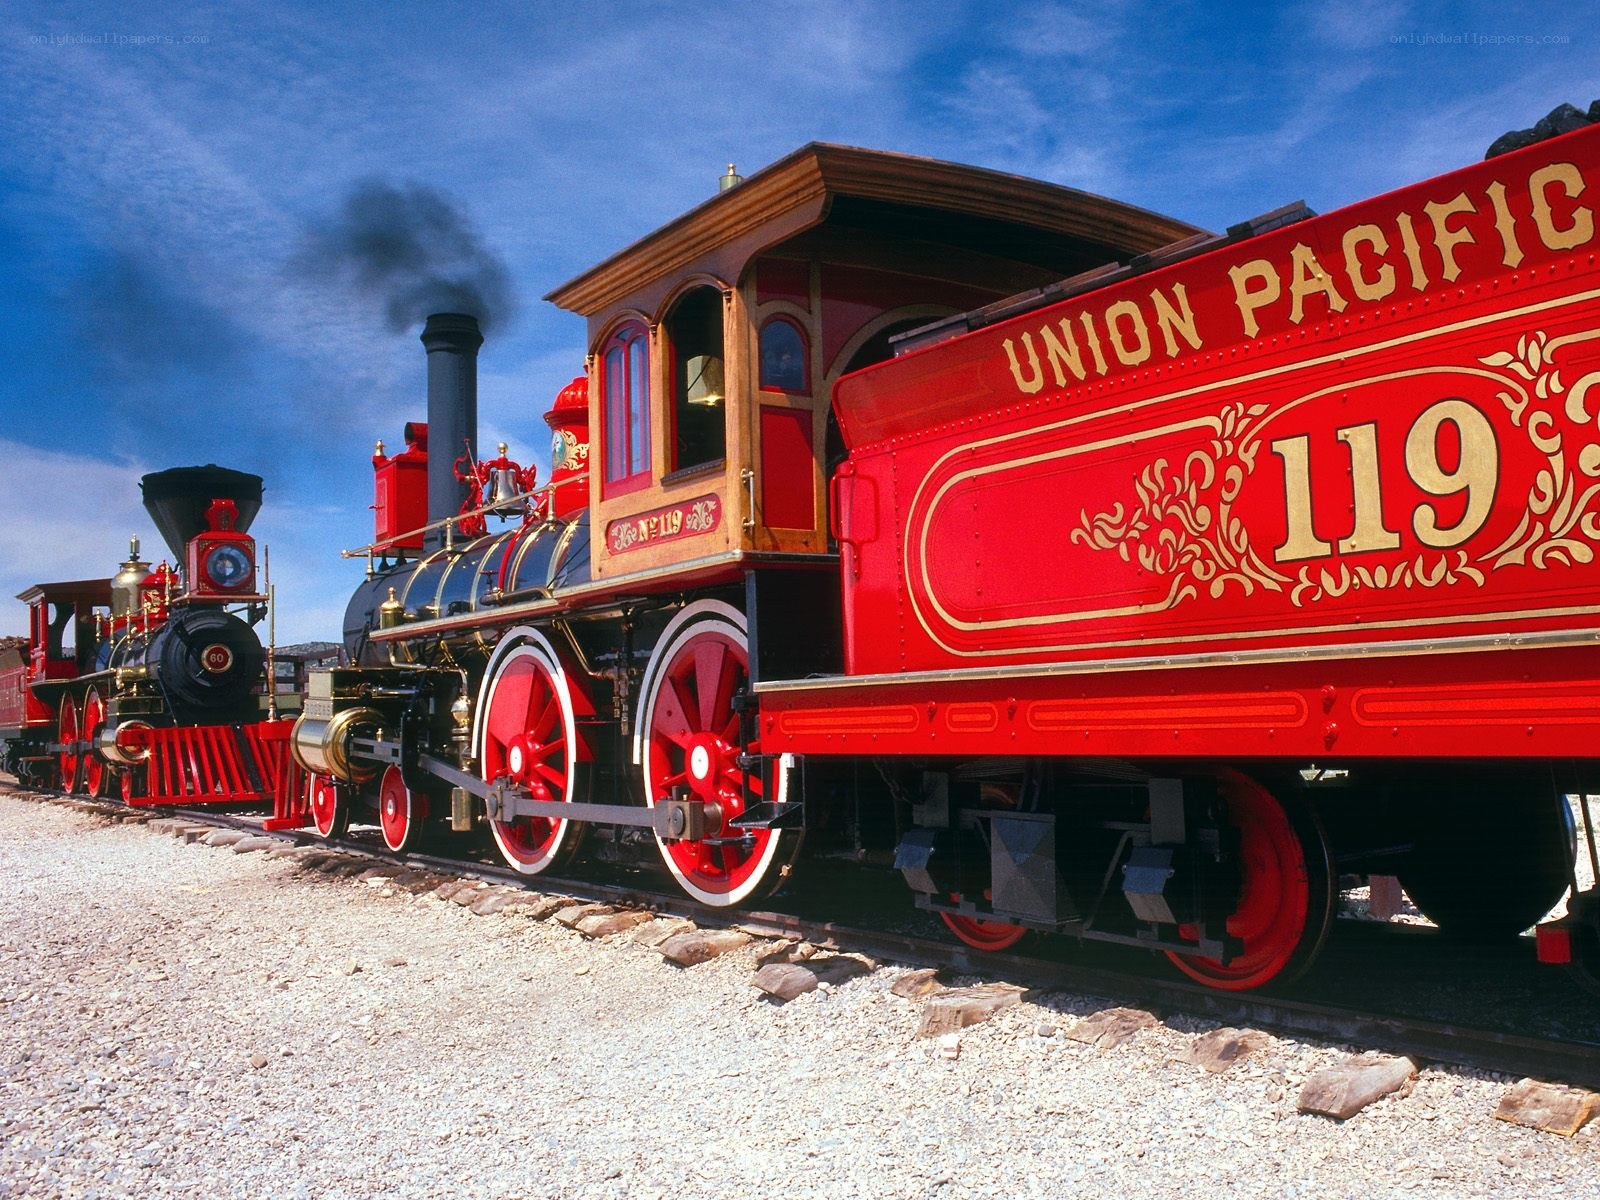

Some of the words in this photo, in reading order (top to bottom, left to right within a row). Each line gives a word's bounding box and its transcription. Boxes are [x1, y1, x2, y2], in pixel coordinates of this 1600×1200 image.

[1001, 281, 1204, 395] UNION
[1227, 162, 1595, 339] PACIFIC
[659, 509, 683, 537] 119
[1270, 398, 1500, 564] 119
[209, 653, 224, 663] 60
